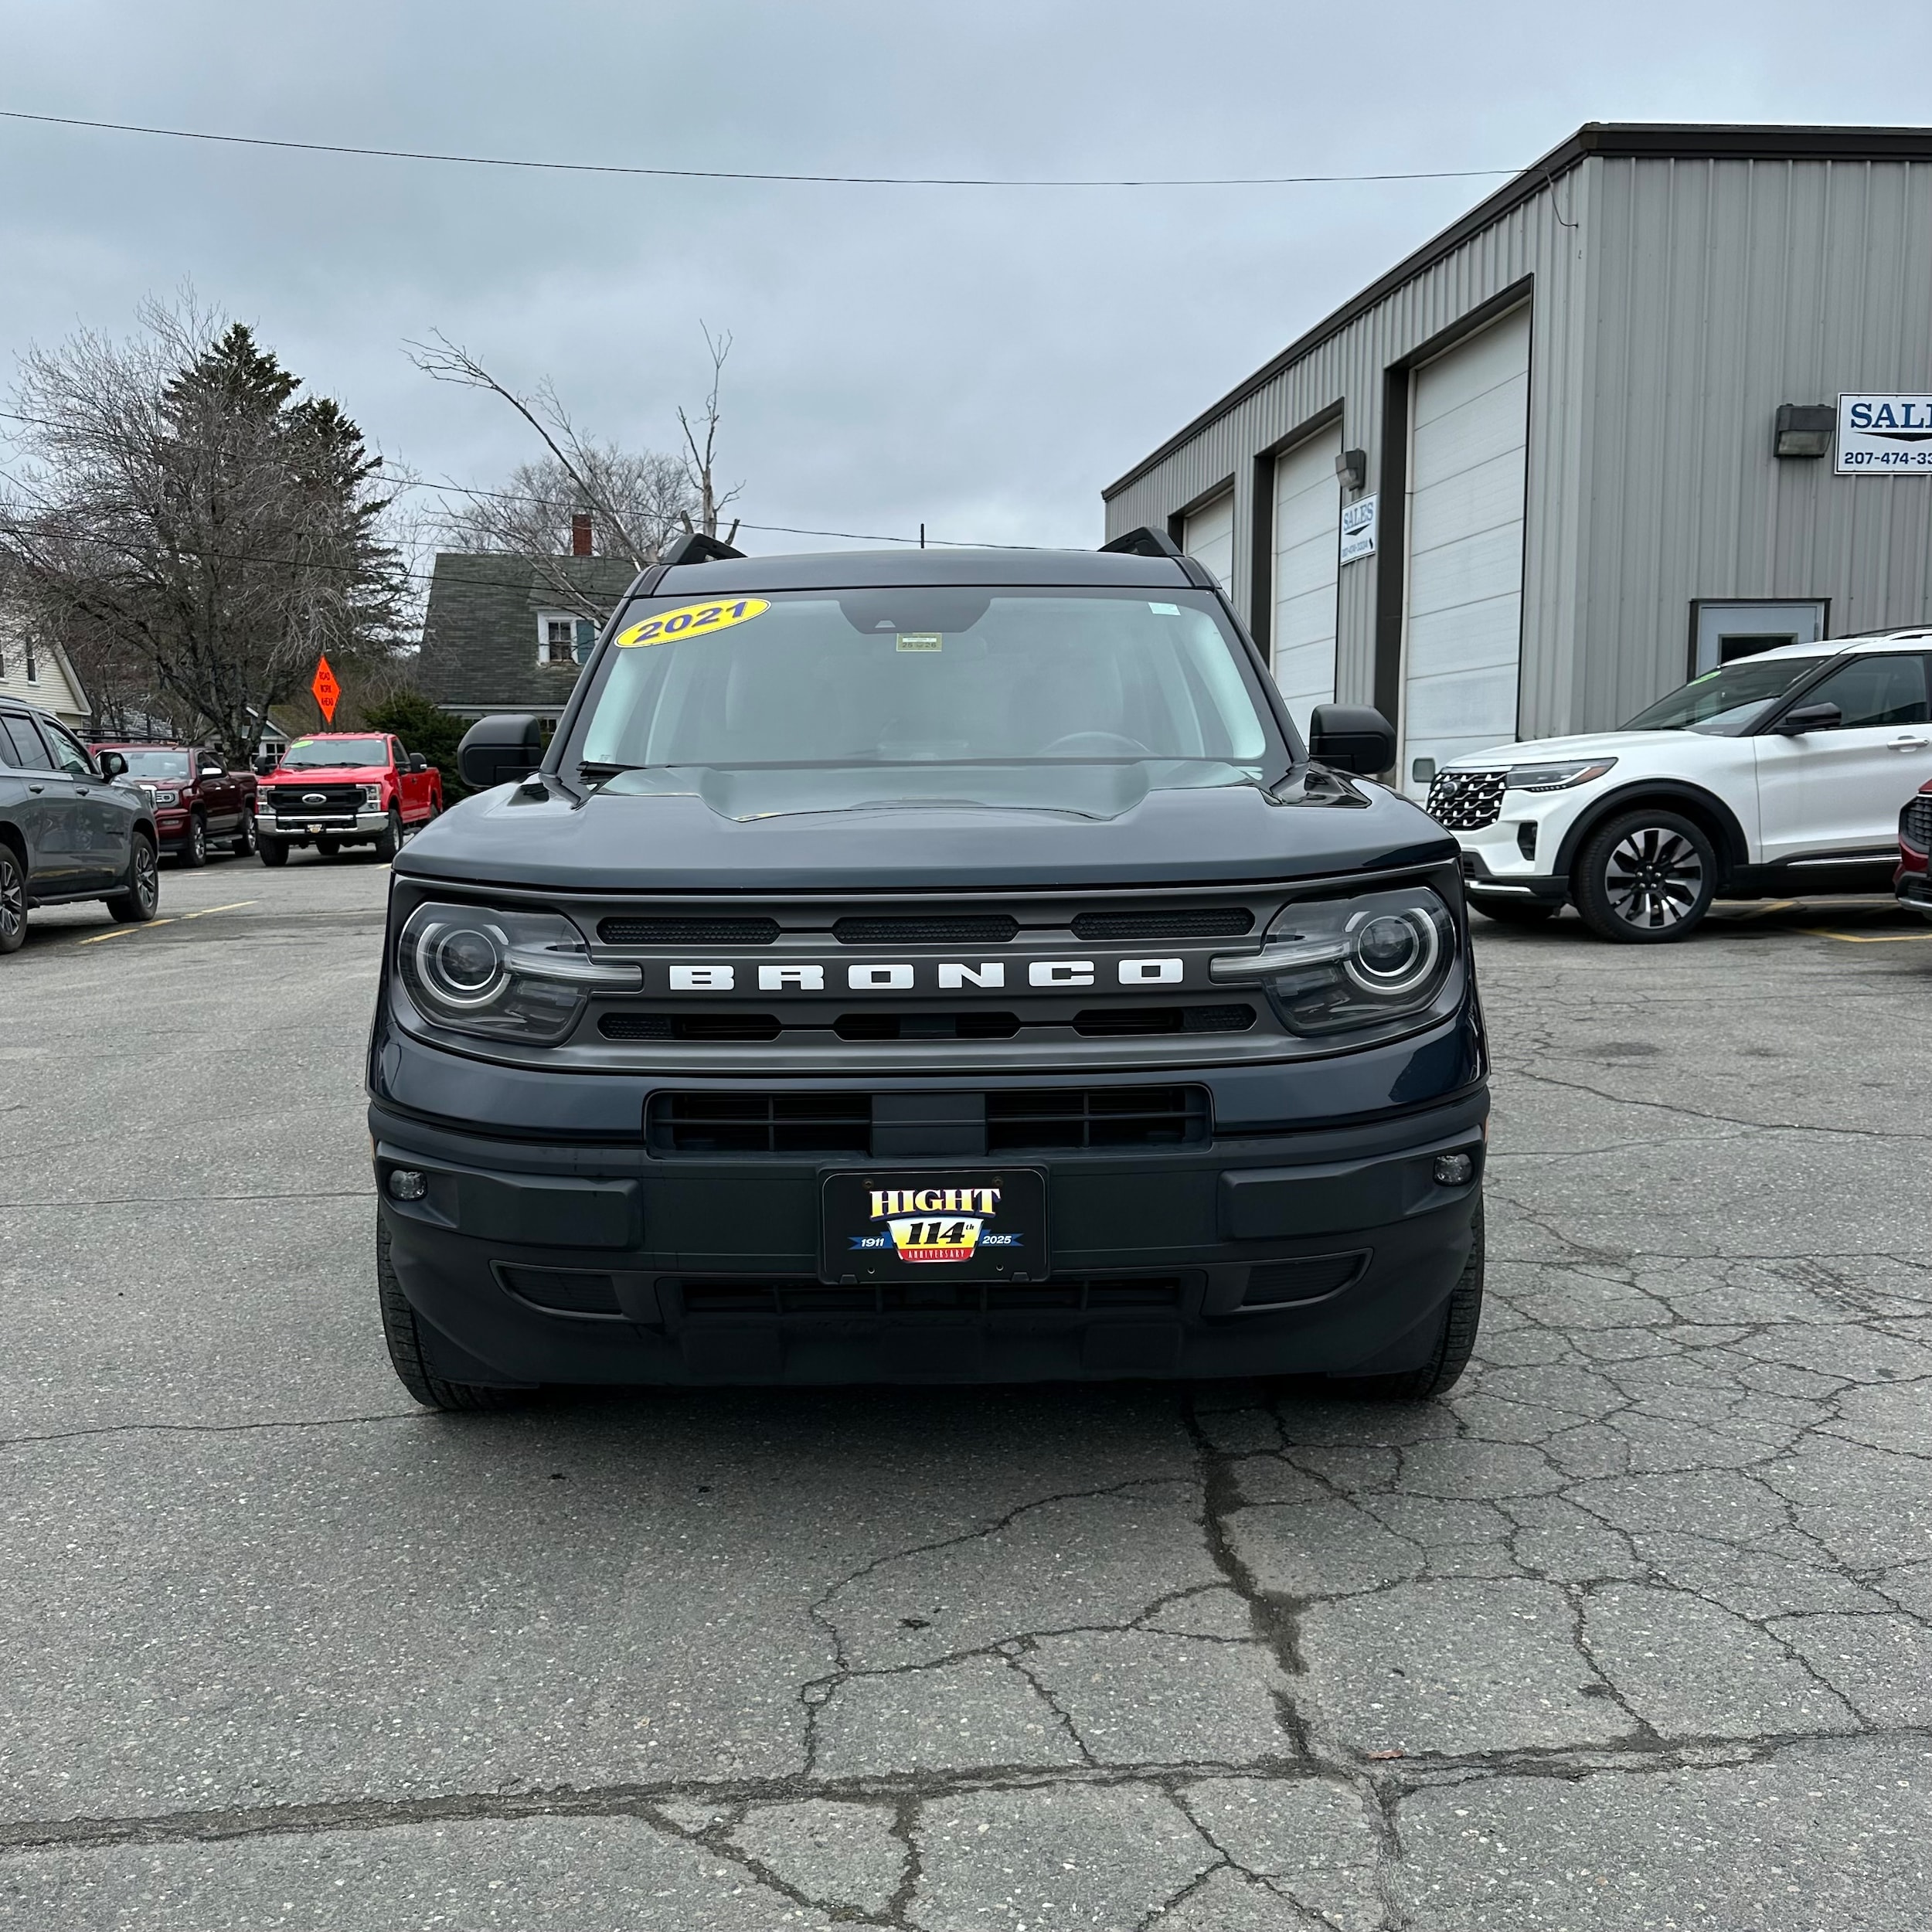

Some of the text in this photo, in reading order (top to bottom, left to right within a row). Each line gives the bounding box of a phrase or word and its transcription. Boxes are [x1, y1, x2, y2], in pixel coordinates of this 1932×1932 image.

[1344, 502, 1373, 531] SALES
[632, 600, 749, 645] 2021
[669, 958, 1184, 990] BRONCO
[869, 1188, 1002, 1220] HIGHT
[861, 1237, 885, 1247] 1911
[908, 1249, 965, 1259] ANNIVERSARY
[982, 1235, 1012, 1244] 2025
